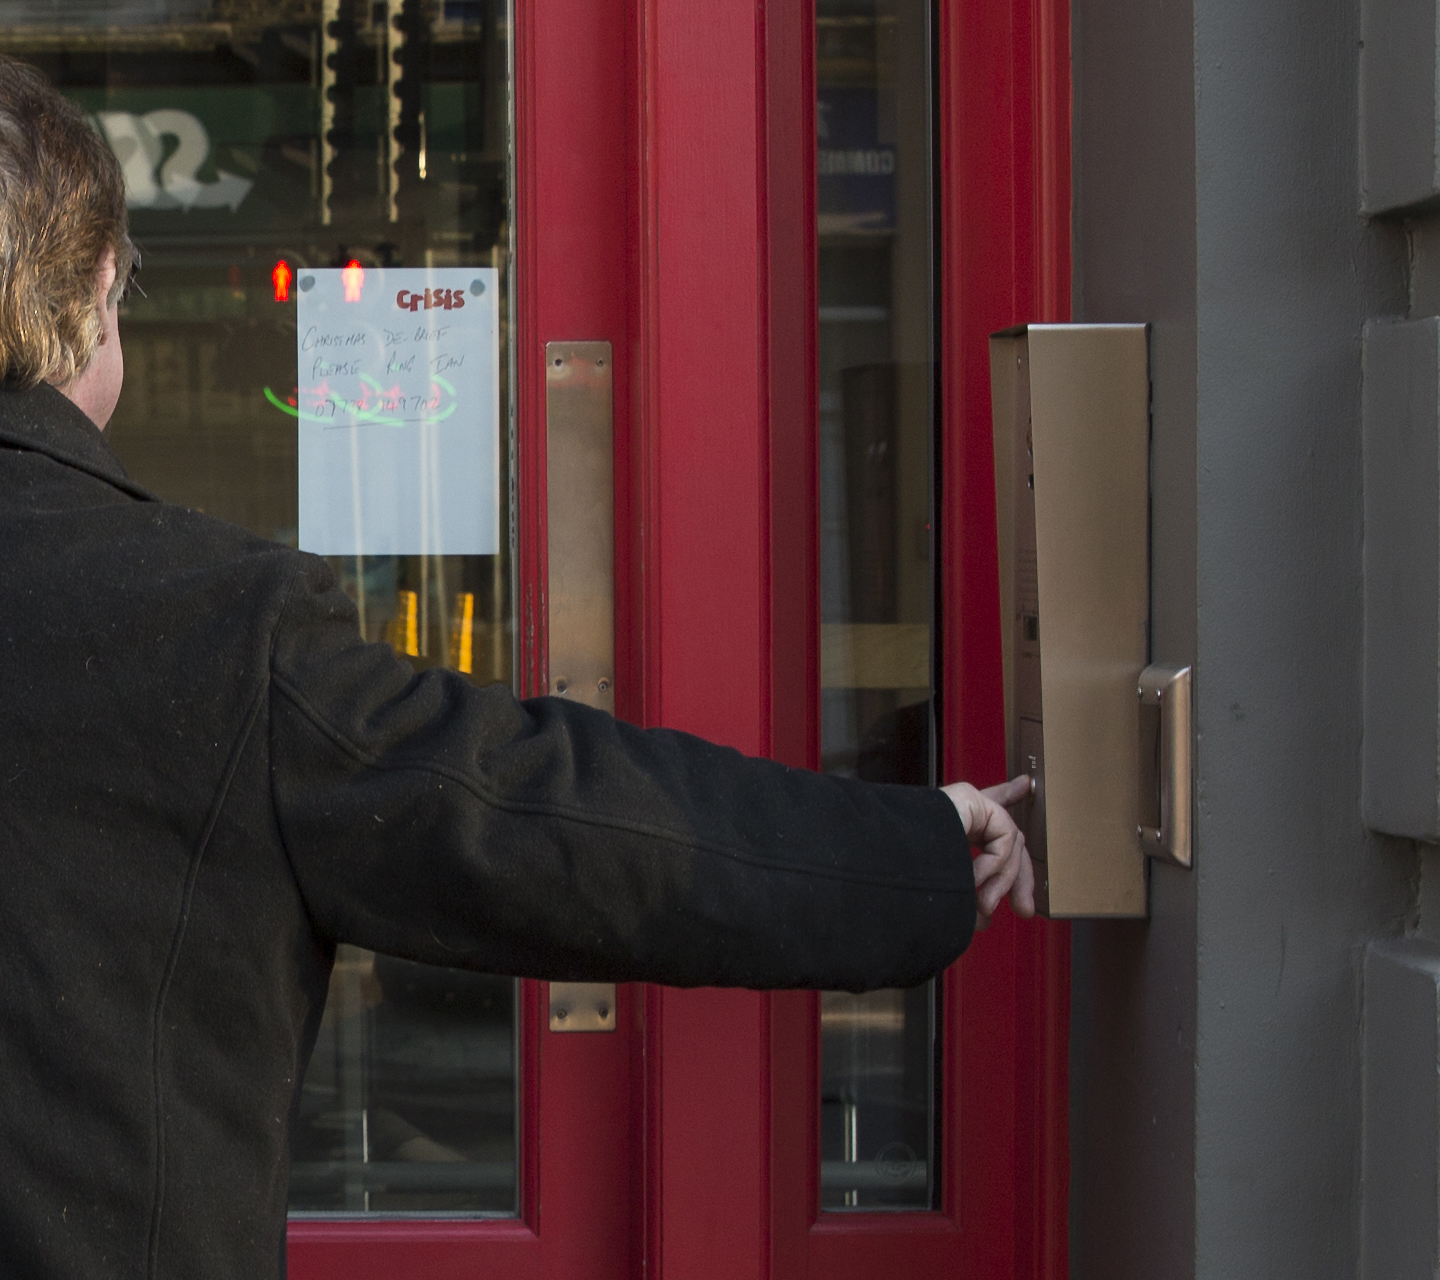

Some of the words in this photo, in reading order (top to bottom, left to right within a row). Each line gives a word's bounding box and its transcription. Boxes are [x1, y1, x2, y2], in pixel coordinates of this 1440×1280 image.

[312, 357, 362, 380] PLEASE
[386, 351, 416, 374] RING
[430, 354, 465, 376] IAN
